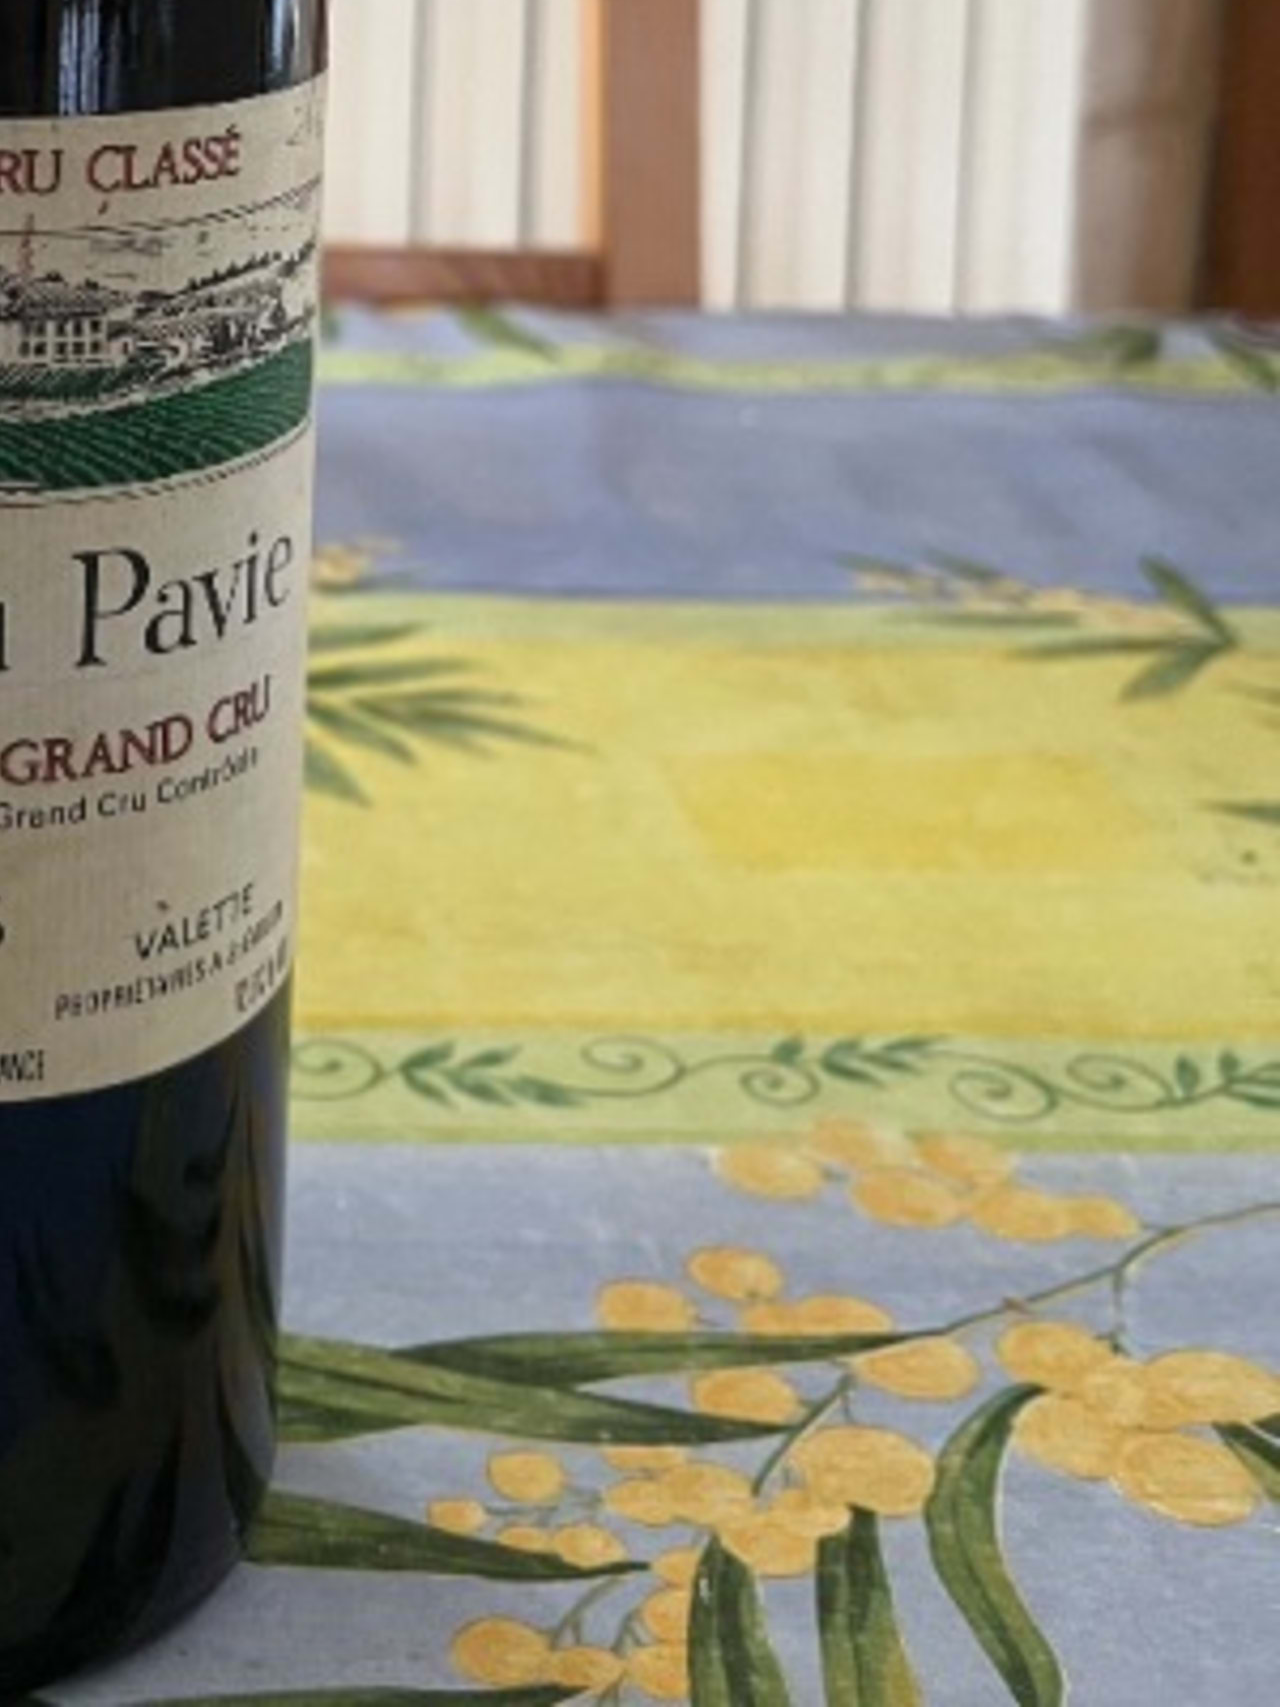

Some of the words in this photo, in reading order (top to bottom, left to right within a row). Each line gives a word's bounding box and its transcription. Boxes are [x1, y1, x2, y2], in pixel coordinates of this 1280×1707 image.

[86, 123, 241, 194] CLASSÉ
[72, 529, 293, 669] Pavie
[207, 673, 271, 744] CRU
[97, 791, 147, 817] Cru
[134, 882, 254, 961] VALETTE
